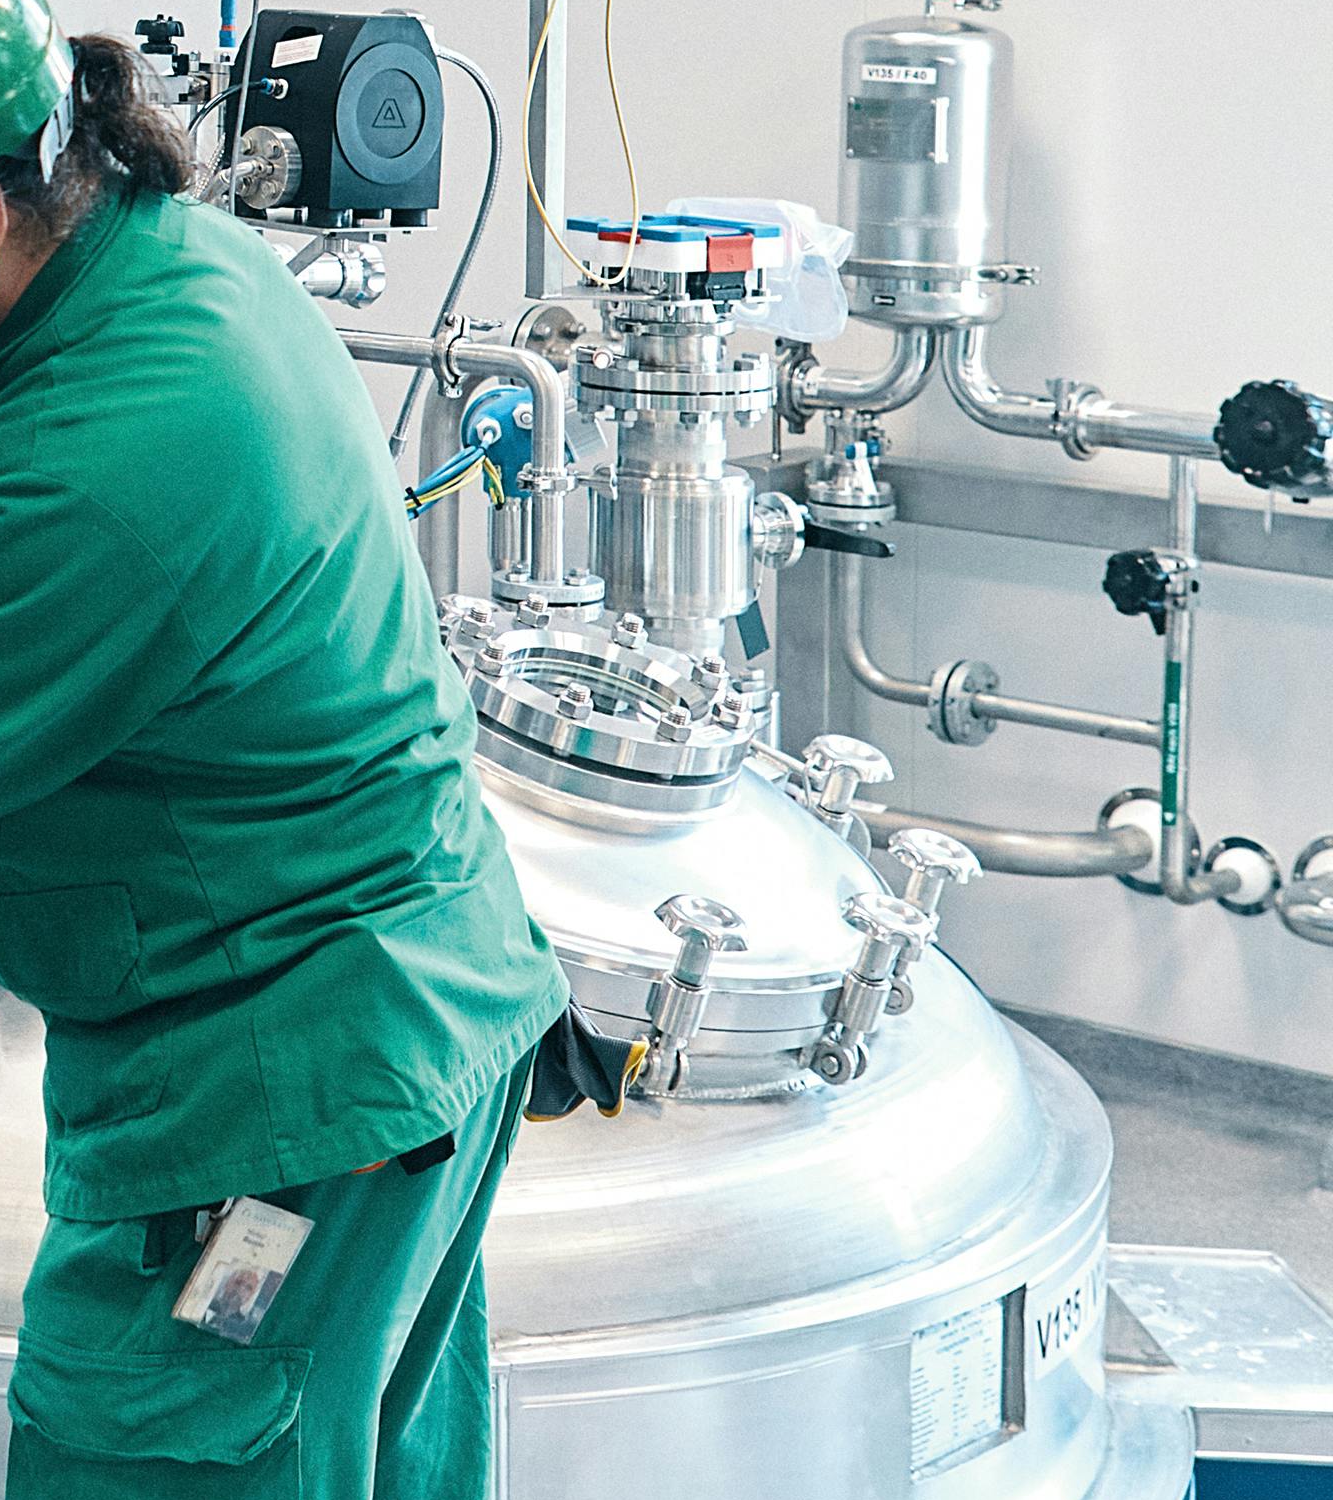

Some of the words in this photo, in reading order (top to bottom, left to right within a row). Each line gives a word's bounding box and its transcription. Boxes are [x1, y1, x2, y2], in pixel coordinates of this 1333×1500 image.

[868, 68, 894, 80] V135
[904, 69, 928, 81] F40
[1036, 1287, 1082, 1359] V135
